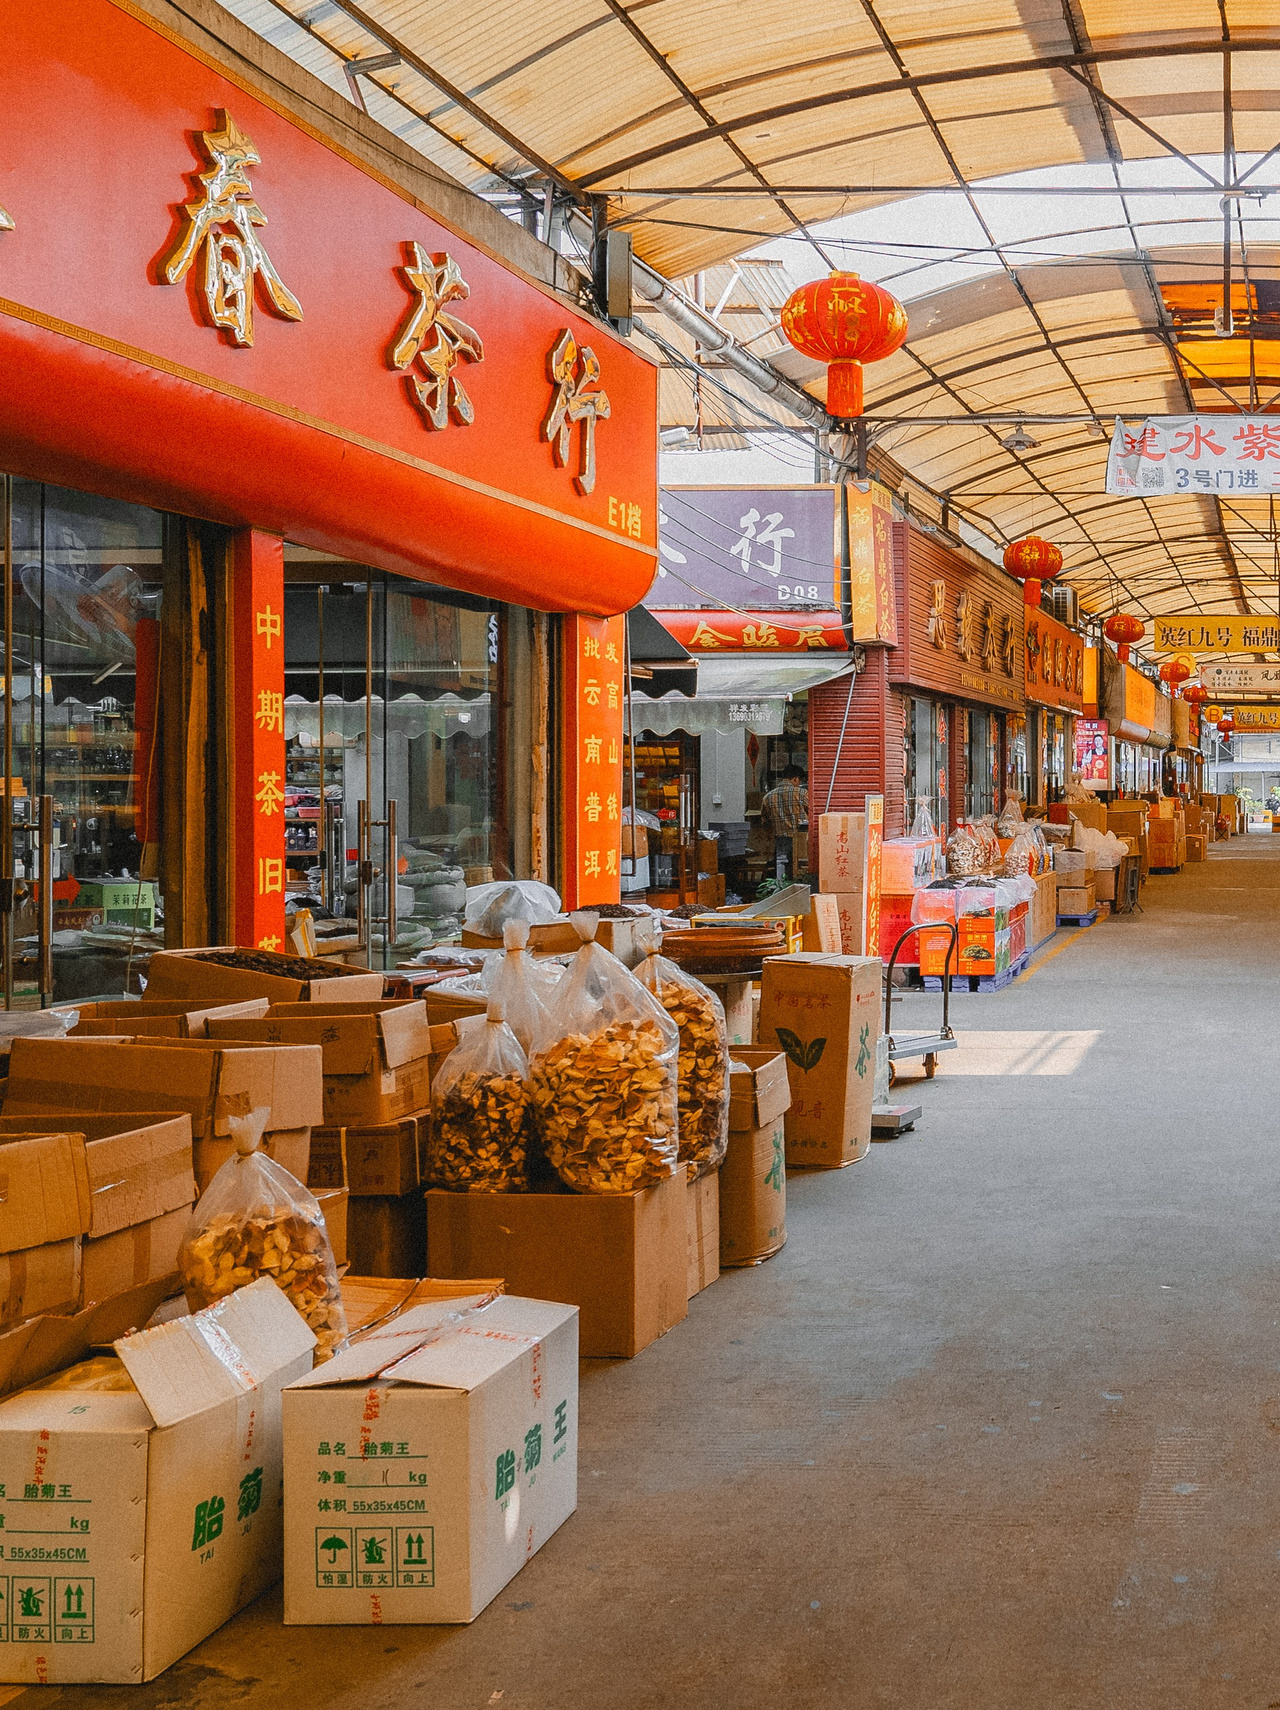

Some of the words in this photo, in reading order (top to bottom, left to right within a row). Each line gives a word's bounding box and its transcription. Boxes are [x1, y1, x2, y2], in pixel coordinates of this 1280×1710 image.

[1175, 466, 1260, 490] 3号门进
[607, 495, 642, 540] E1档
[851, 505, 875, 616] 福鼎白茶
[777, 585, 819, 600] D08
[1160, 626, 1234, 648] 英红九号
[1209, 708, 1221, 722] B
[1237, 712, 1279, 725] 英红九号
[836, 831, 851, 878] 高山红茶
[112, 893, 148, 907] 茉莉花茶
[773, 991, 832, 1010] 中国名茶
[317, 1441, 346, 1456] 品名
[363, 1441, 411, 1456] 胎菊王
[494, 1398, 569, 1501] 胎菊王
[317, 1470, 347, 1485] 净重
[408, 1470, 428, 1485] kg
[23, 1484, 73, 1499] 胎菊王
[317, 1498, 348, 1513] 体积
[352, 1499, 426, 1512] 55x35x45CM
[69, 1516, 90, 1532] kg
[9, 1547, 87, 1560] 55x35x45CM
[362, 1573, 389, 1585] 防火
[403, 1573, 430, 1585] 向上
[17, 1626, 46, 1640] 防火
[61, 1626, 89, 1640] 向上
